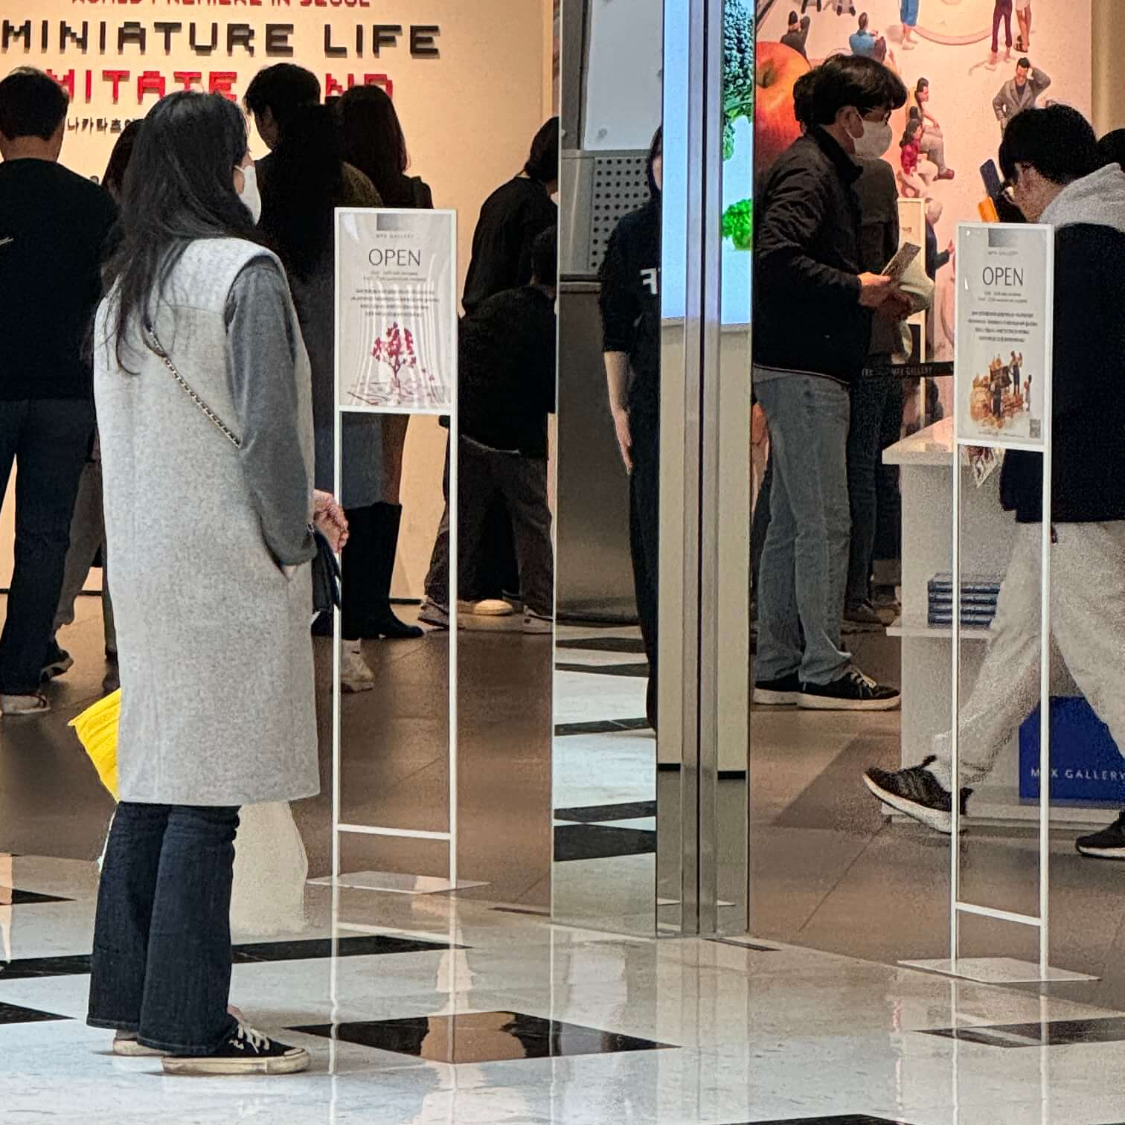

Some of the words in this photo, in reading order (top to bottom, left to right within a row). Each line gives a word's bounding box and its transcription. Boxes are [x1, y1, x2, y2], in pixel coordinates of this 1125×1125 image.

[1, 19, 295, 57] MINIATURE
[323, 23, 440, 59] LIFE
[368, 248, 421, 266] OPEN
[982, 266, 1024, 286] OPEN
[1030, 768, 1059, 779] MX
[1064, 768, 1125, 782] GALLERY
